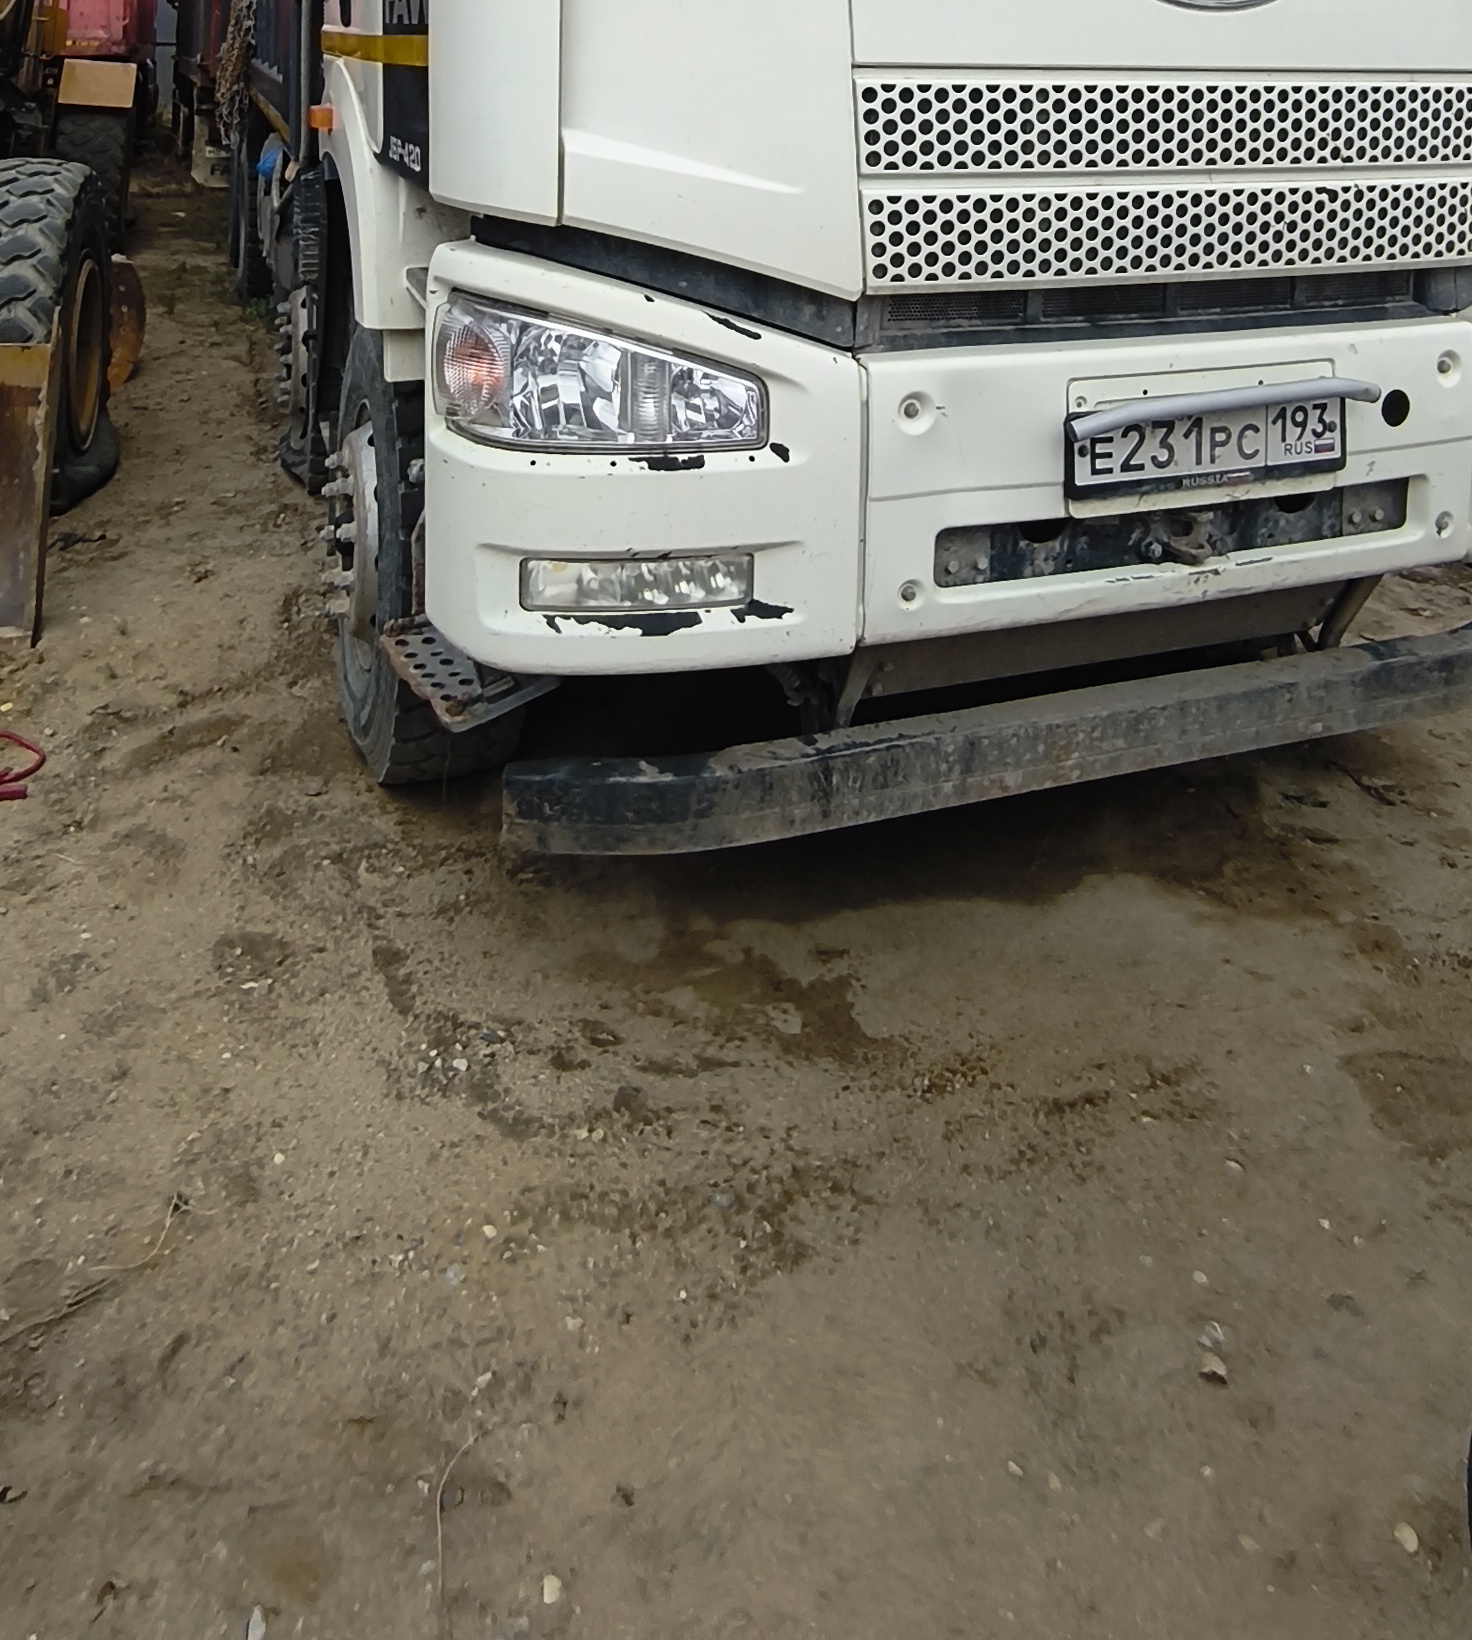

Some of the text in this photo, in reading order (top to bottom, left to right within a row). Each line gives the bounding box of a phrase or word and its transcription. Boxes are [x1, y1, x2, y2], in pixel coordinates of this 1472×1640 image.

[1271, 402, 1328, 443] 193
[1284, 440, 1313, 456] RUS
[1182, 473, 1229, 488] RUSSIA
